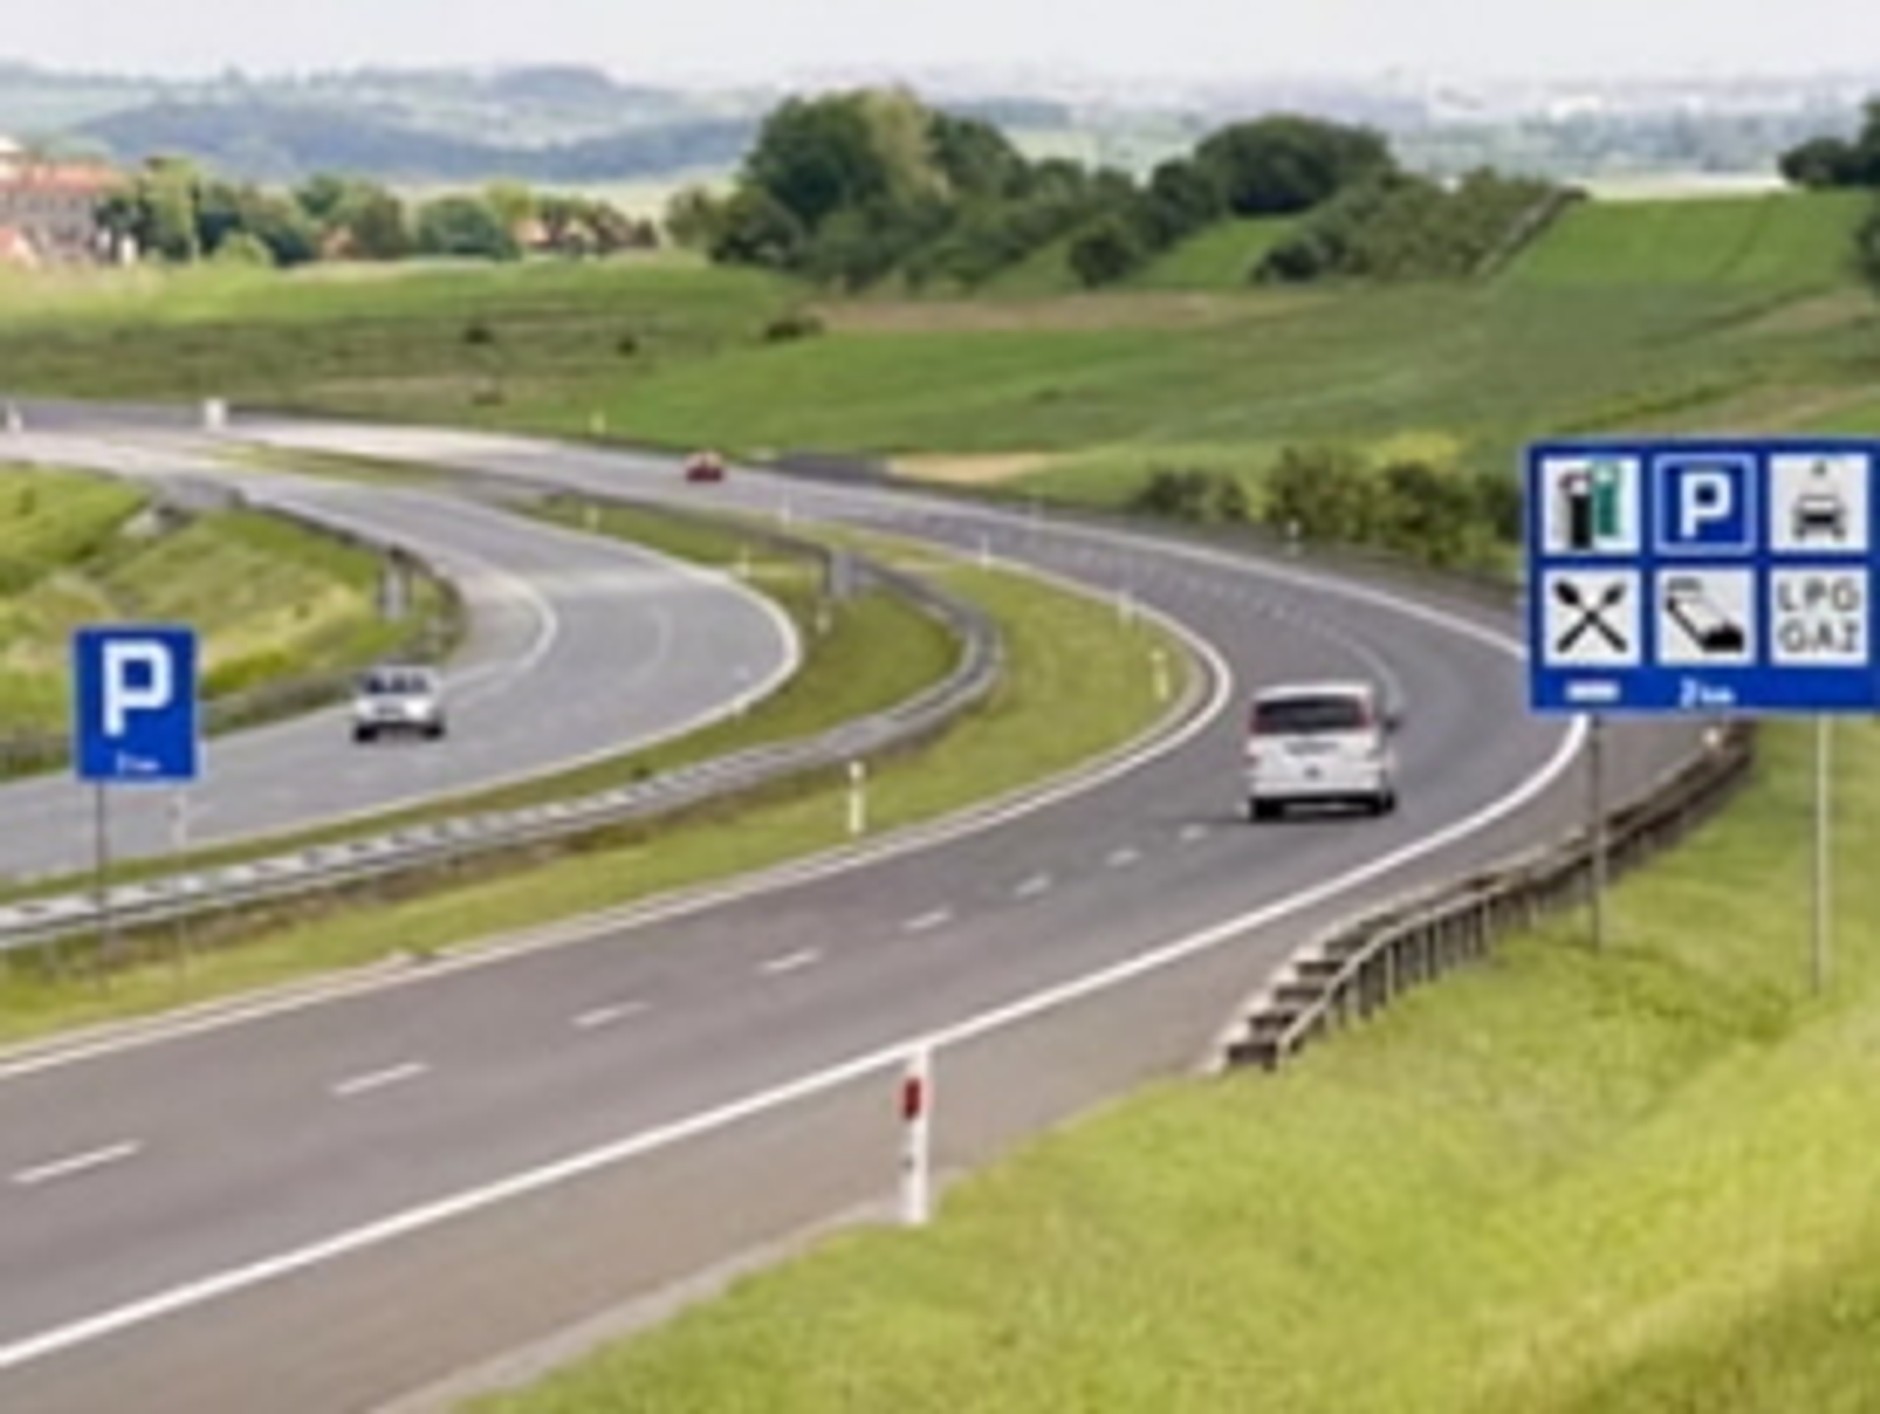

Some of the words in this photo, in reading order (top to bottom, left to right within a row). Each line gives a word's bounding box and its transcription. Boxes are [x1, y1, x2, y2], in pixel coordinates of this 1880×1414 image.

[1681, 472, 1732, 539] P
[1777, 578, 1861, 612] LPG
[103, 639, 172, 737] P
